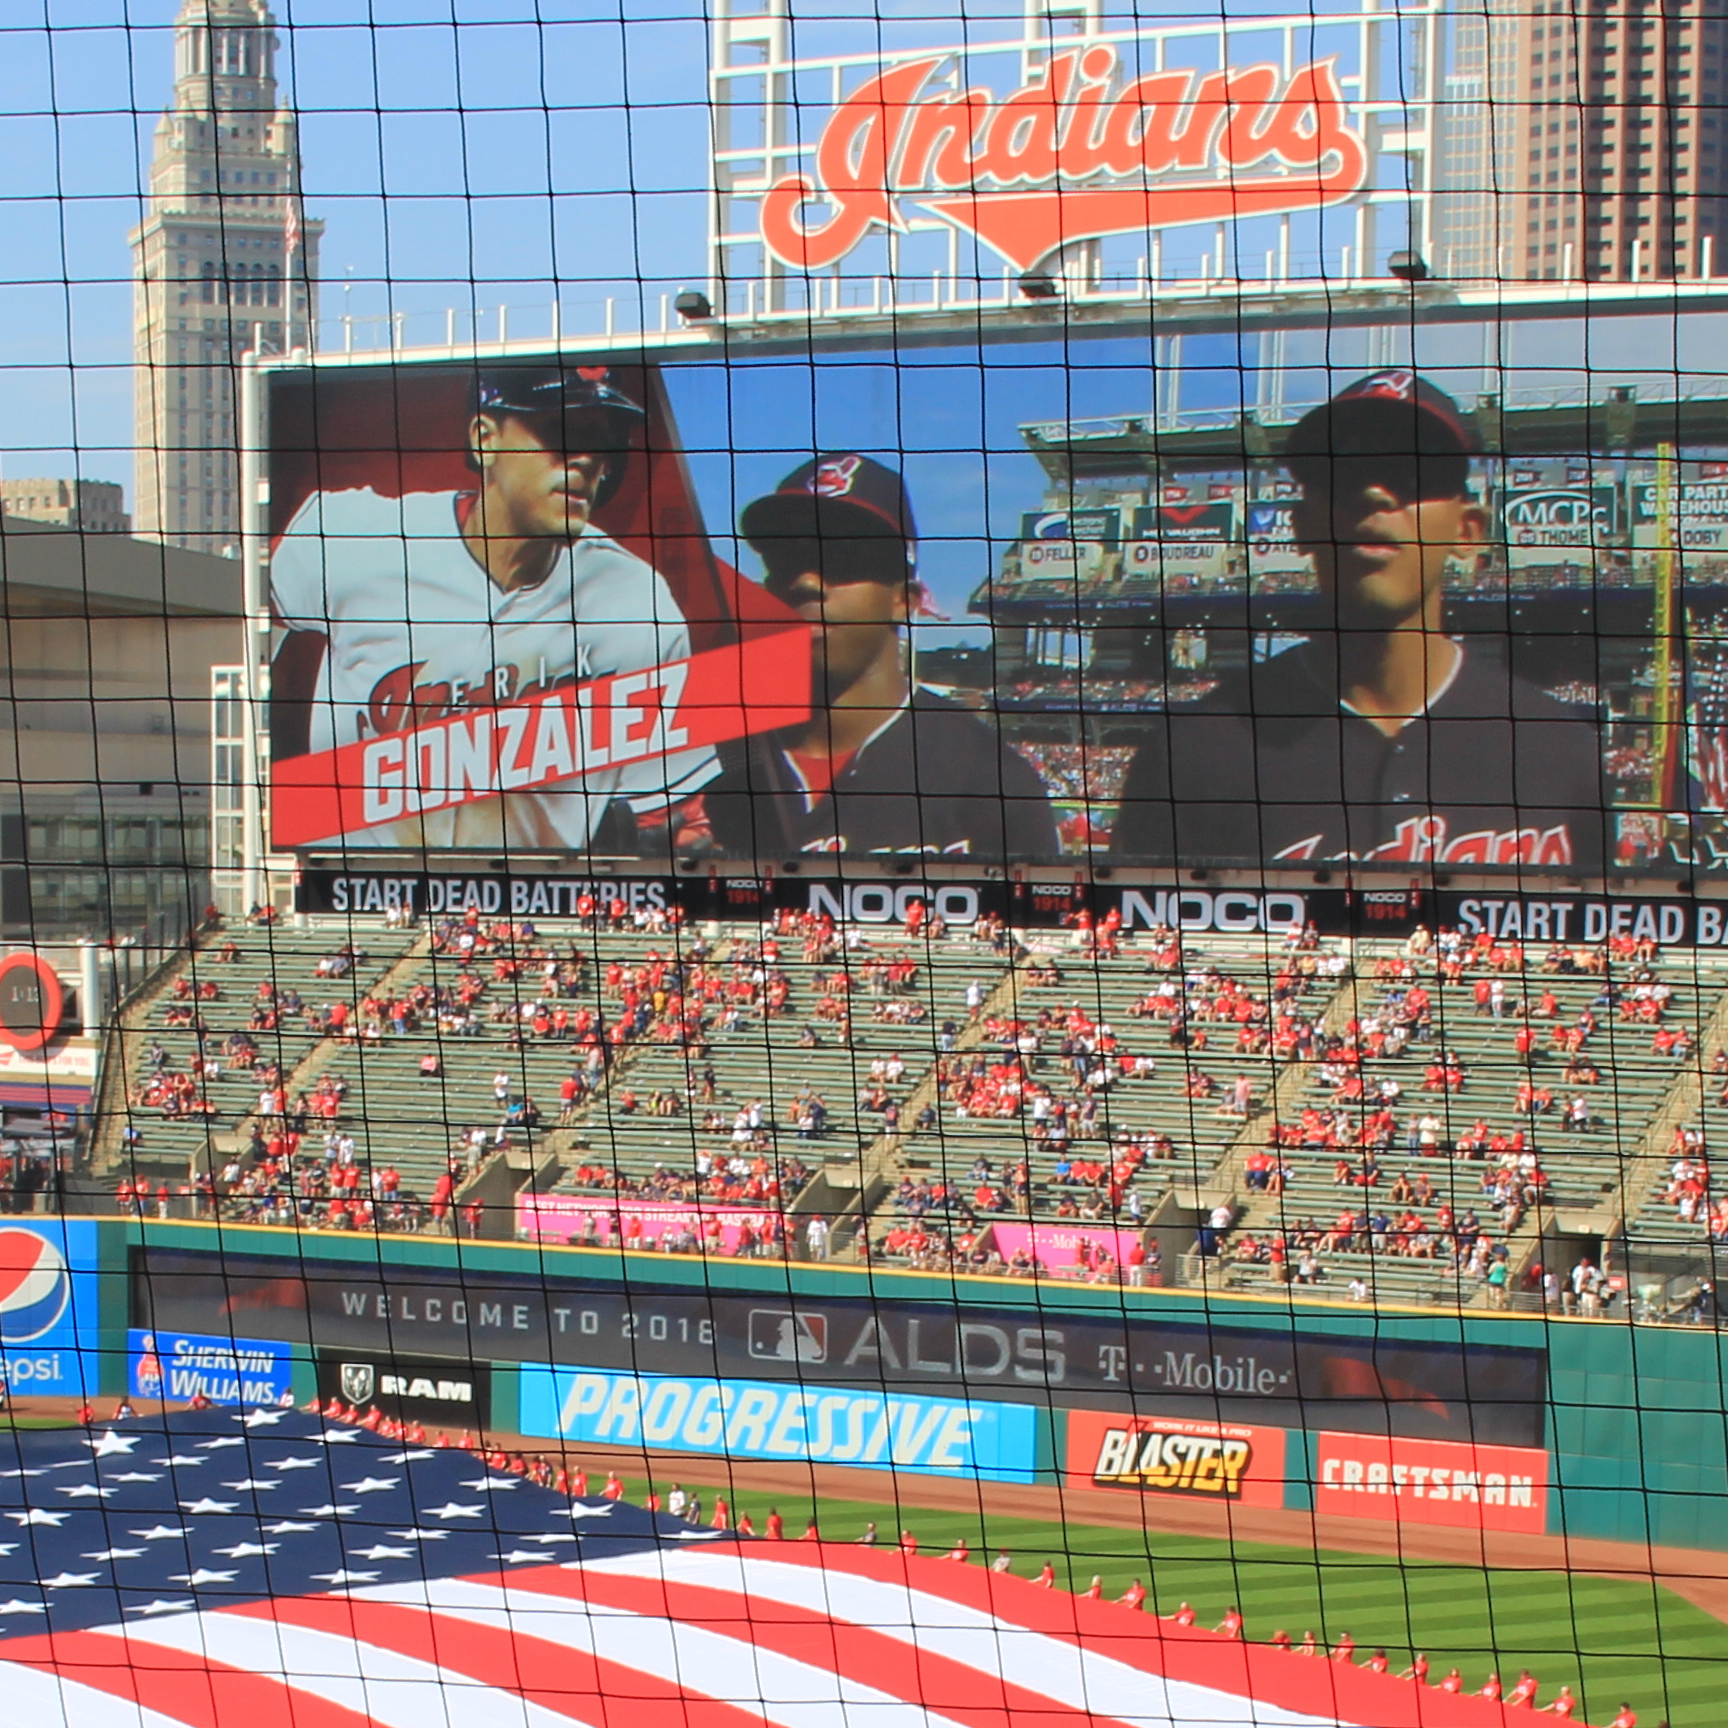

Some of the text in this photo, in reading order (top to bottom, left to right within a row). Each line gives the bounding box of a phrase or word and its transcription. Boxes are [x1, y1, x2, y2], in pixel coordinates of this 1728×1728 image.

[759, 43, 1369, 272] Indians
[1645, 486, 1680, 500] CR
[451, 644, 594, 707] ERIK
[362, 660, 690, 824] GONZALEZ
[332, 877, 418, 912] START
[426, 879, 501, 914] DEAD
[808, 883, 980, 924] NOCO
[1031, 885, 1073, 895] NOCO
[1033, 896, 1072, 912] 1914
[1363, 892, 1406, 903] NOCO
[1121, 890, 1306, 933] NOCO
[1365, 904, 1407, 920] 1914
[1458, 899, 1574, 941] START
[1584, 902, 1686, 945] DEAD
[525, 1200, 554, 1215] BEST
[171, 1339, 275, 1374] SHERWIN
[341, 1292, 530, 1331] WELCOME
[554, 1308, 599, 1336] TO
[621, 1313, 718, 1345] 2018
[844, 1317, 1067, 1383] ALDS
[381, 1374, 472, 1401] RAM
[557, 1373, 984, 1468] PROGRESSIVE
[1094, 1422, 1249, 1494] BLASTER
[1323, 1458, 1533, 1508] CRAFTSMAN
